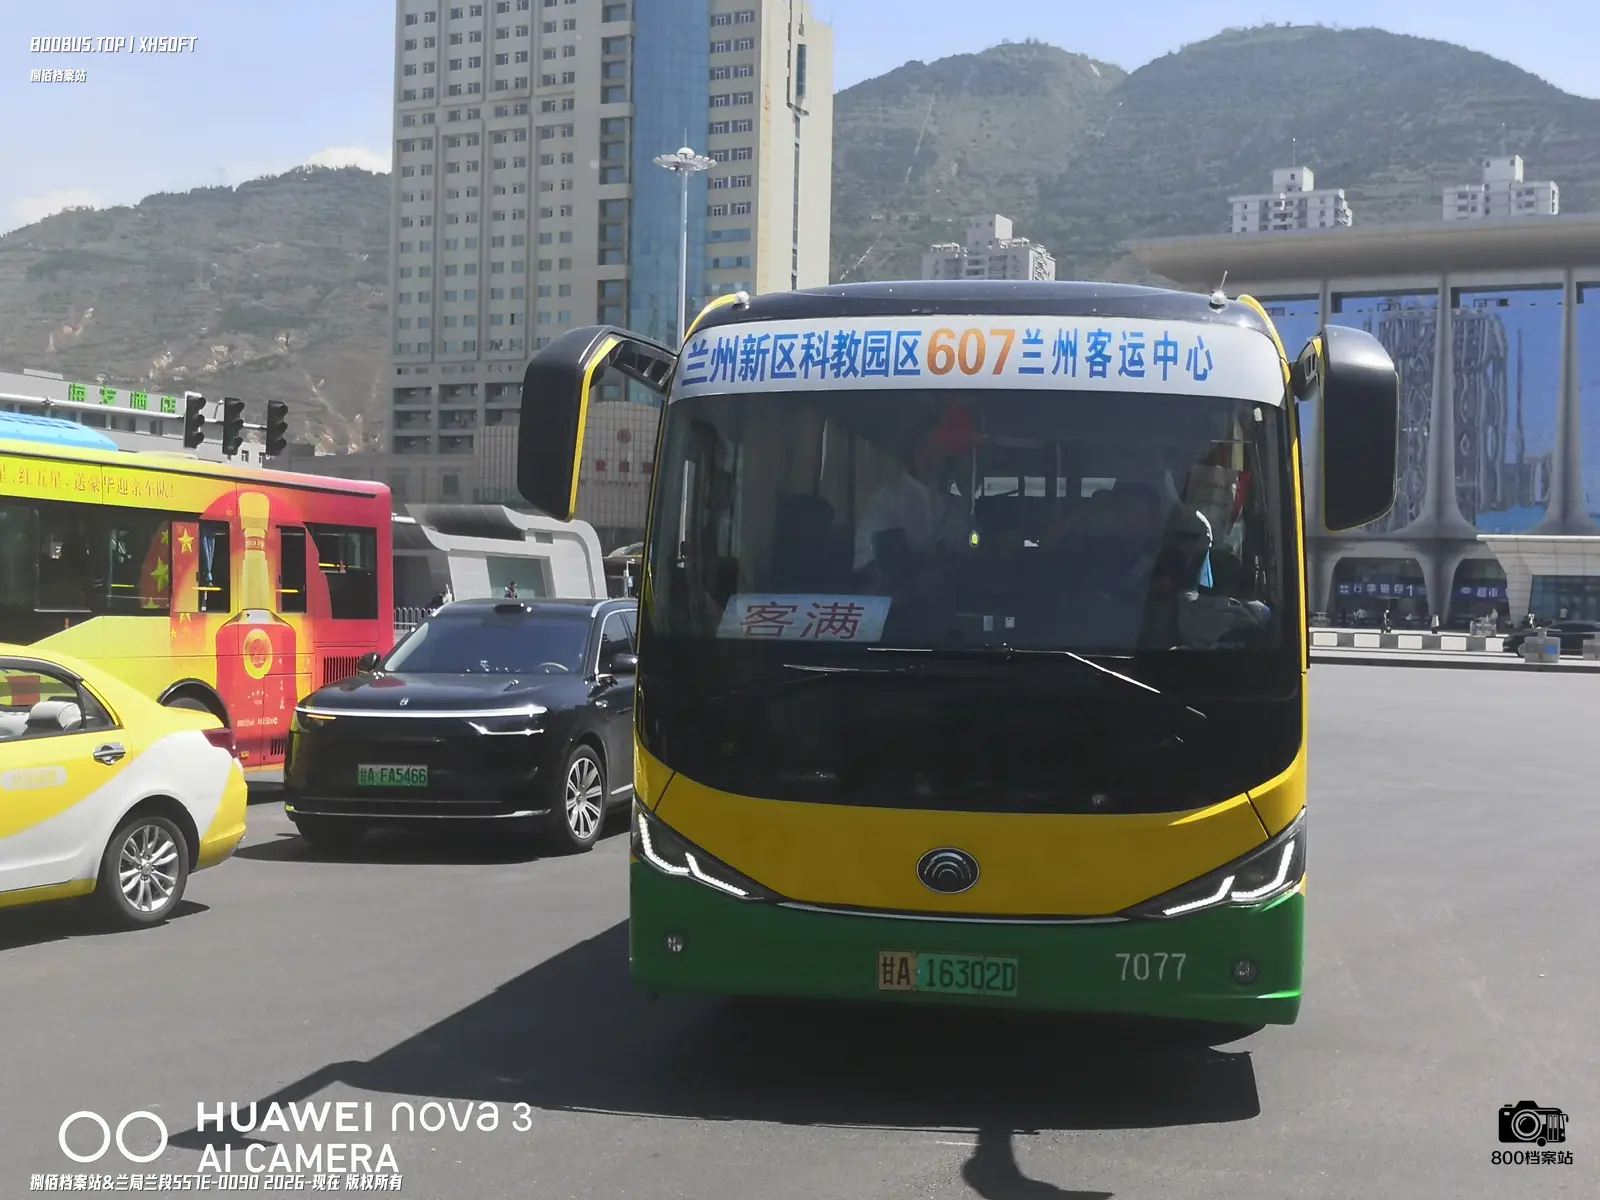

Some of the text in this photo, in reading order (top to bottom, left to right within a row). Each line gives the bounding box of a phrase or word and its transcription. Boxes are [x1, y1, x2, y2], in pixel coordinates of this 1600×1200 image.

[681, 327, 1214, 387] 兰州新区科教园区 607 兰州客运中心
[739, 600, 865, 640] 客满
[380, 768, 427, 784] FA5466
[925, 958, 1017, 992] 16302D
[1115, 952, 1187, 981] 7077
